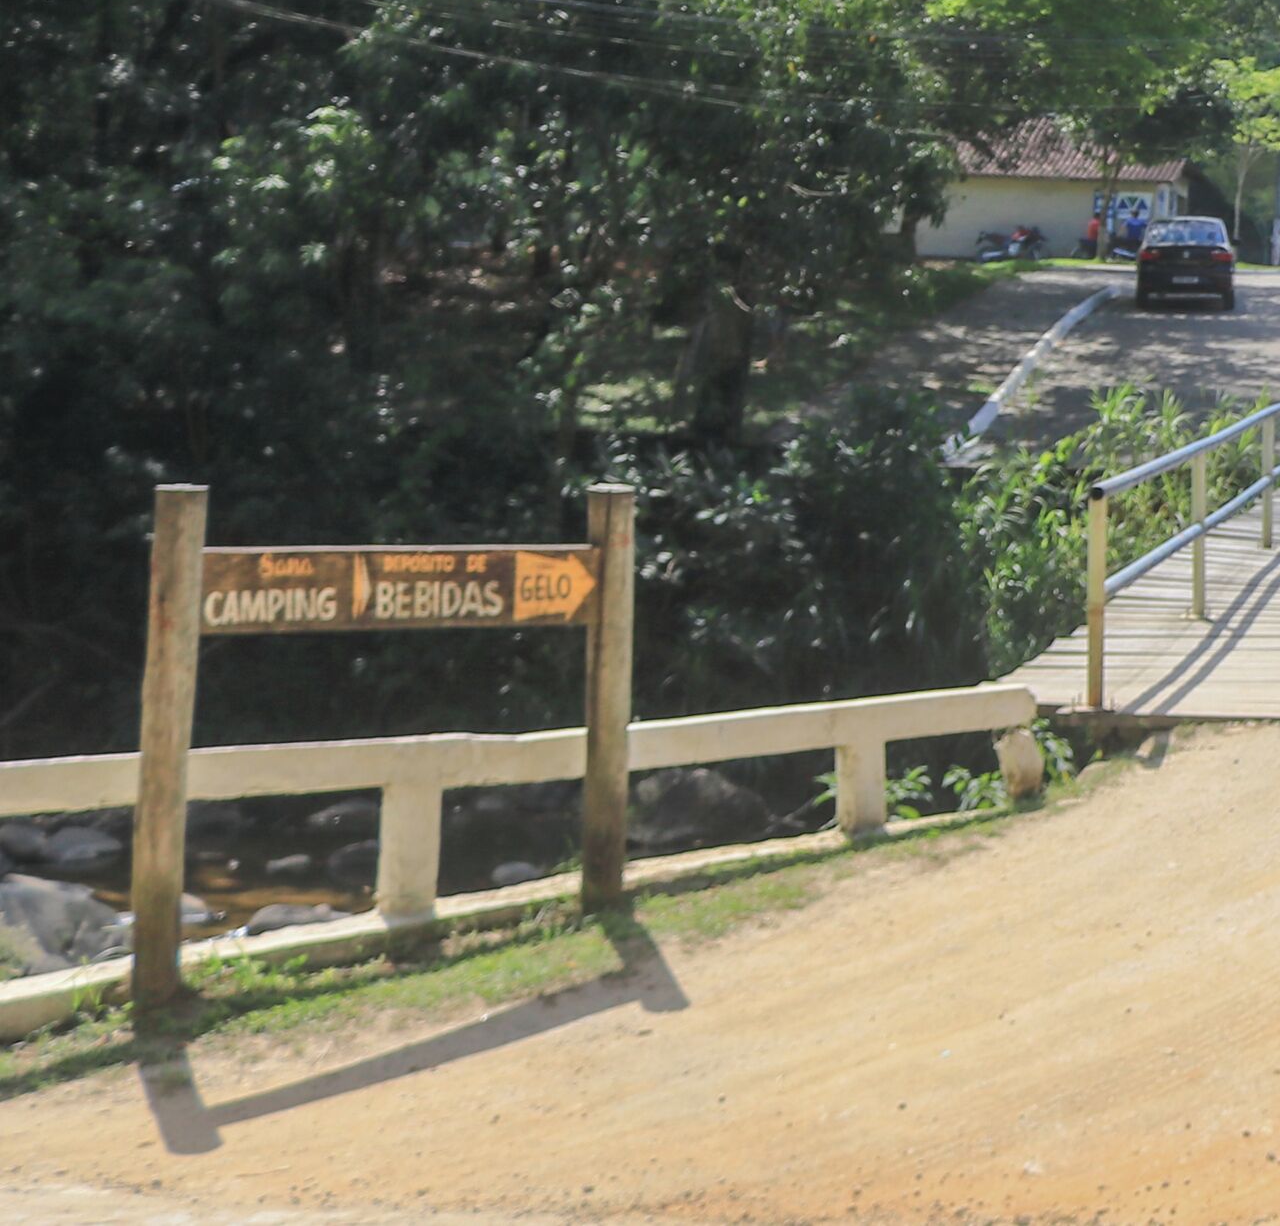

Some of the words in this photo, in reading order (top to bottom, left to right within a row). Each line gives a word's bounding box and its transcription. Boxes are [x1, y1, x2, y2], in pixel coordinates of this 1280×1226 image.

[204, 586, 338, 626] CAMPING
[374, 579, 504, 620] BEBIDAS
[520, 574, 573, 602] GELO
